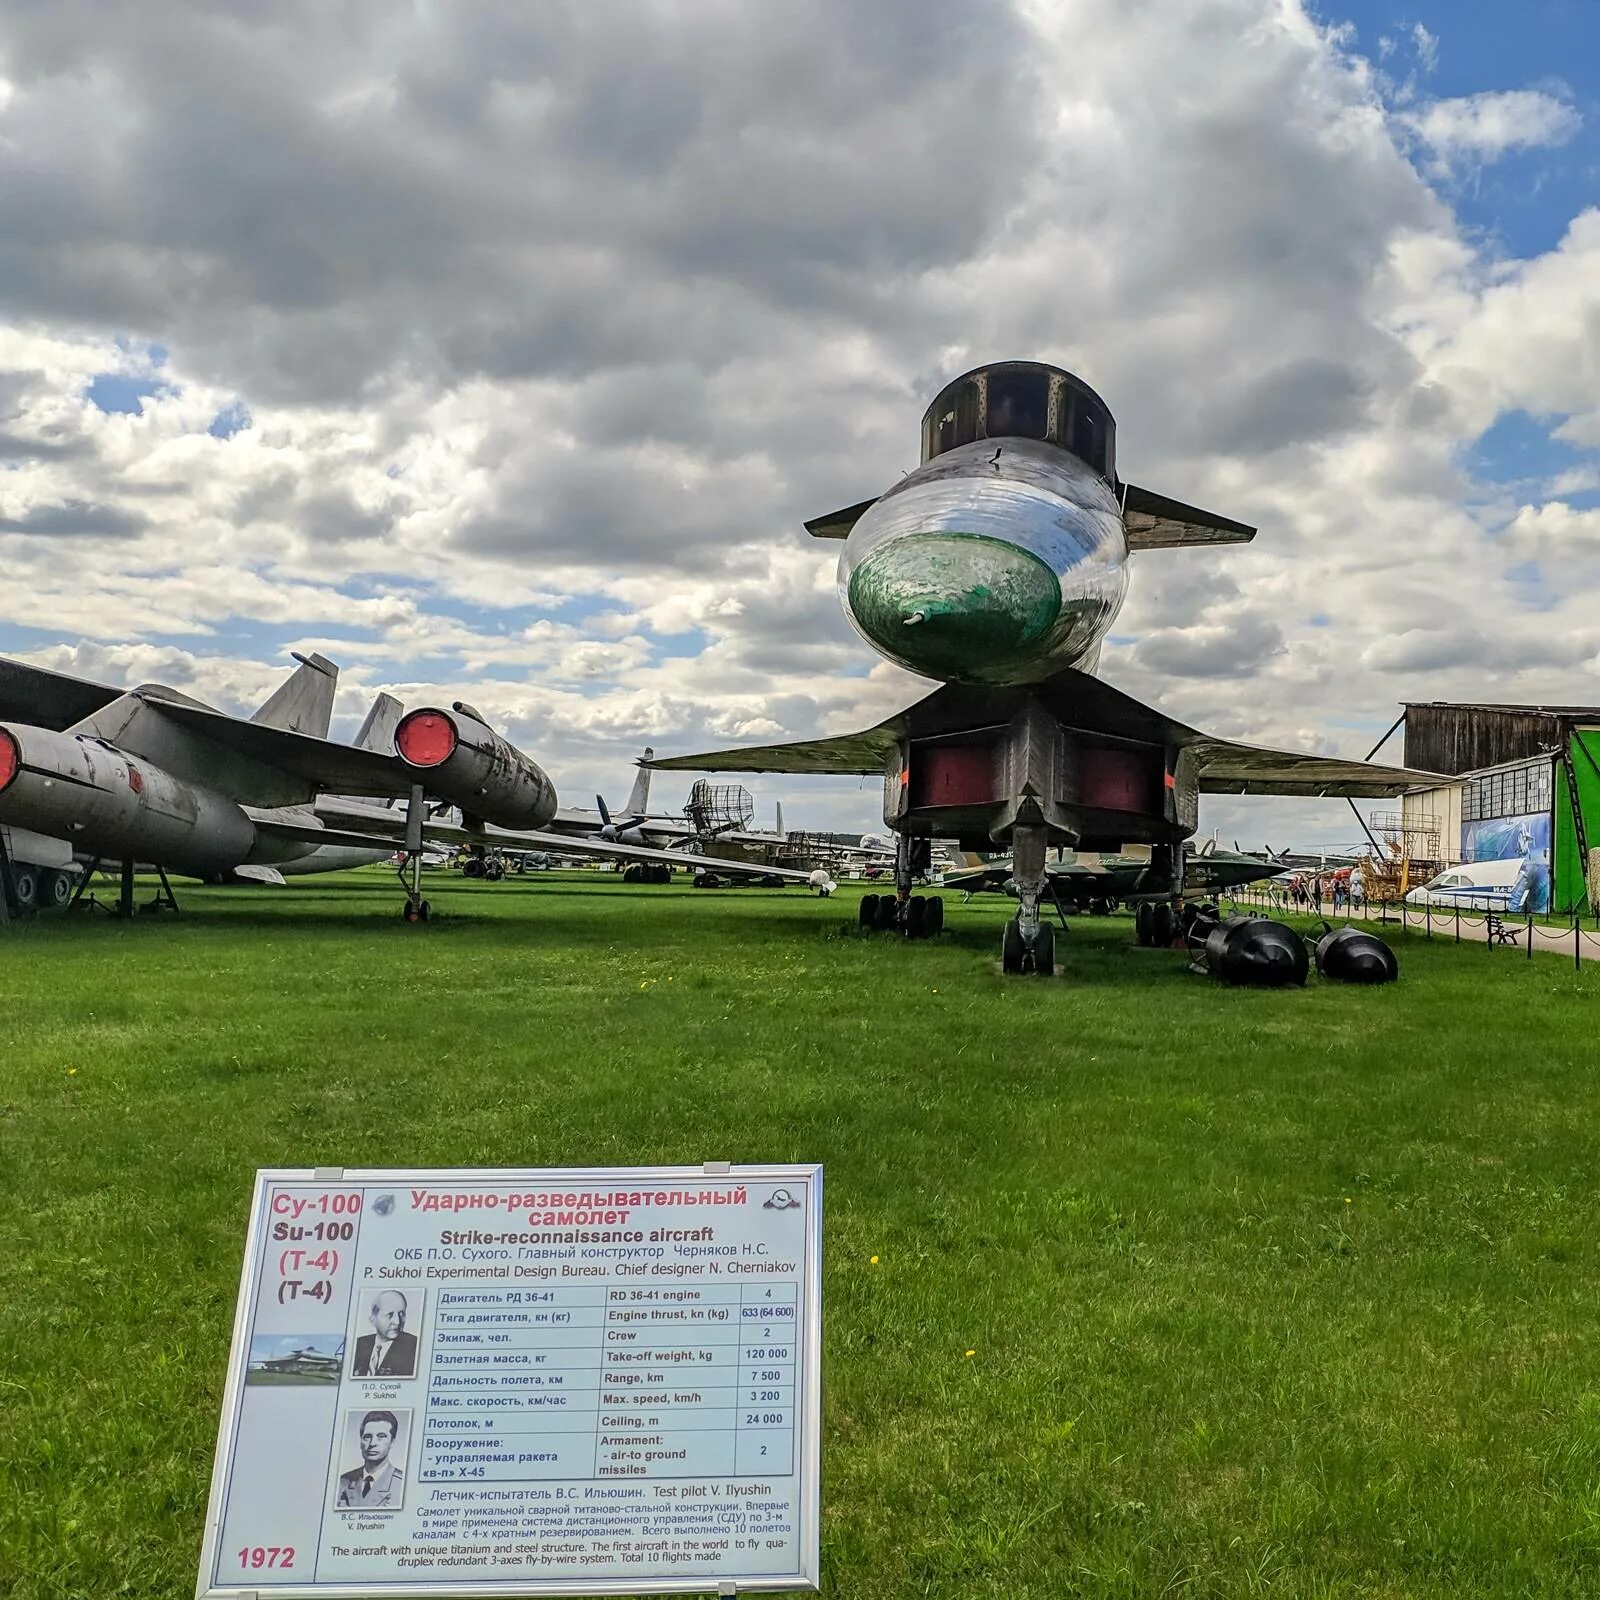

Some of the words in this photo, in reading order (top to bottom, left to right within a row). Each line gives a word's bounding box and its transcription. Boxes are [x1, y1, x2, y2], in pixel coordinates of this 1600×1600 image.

[411, 1186, 746, 1212] Ударно-разведывательный
[272, 1193, 361, 1219] Су-100
[528, 1210, 630, 1226] самолет
[272, 1221, 353, 1241] Su-100
[440, 1228, 643, 1245] Strike-reconnaissance
[649, 1226, 714, 1242] aircraft
[393, 1247, 422, 1260] ОКБ
[427, 1247, 456, 1260] П.О.
[461, 1247, 512, 1262] Сухого.
[517, 1245, 576, 1259] Главный
[580, 1247, 664, 1260] конструктор
[673, 1244, 737, 1259] Черняков
[742, 1242, 768, 1255] Н.С.
[363, 1266, 373, 1278] P.
[378, 1266, 422, 1278] Sukhoi
[426, 1265, 509, 1280] Experimental
[513, 1265, 557, 1279] Design
[561, 1264, 609, 1276] Bureau.
[614, 1262, 648, 1275] Chief
[651, 1262, 705, 1277] designer
[709, 1261, 722, 1274] N.
[727, 1260, 796, 1273] Cherniakov
[440, 1293, 502, 1304] Двигатель
[506, 1292, 521, 1303] РД
[524, 1292, 554, 1302] 36-41
[609, 1291, 626, 1300] RD
[630, 1290, 658, 1300] 36-41
[662, 1289, 700, 1301] engine
[765, 1288, 771, 1298] 4
[439, 1313, 464, 1322] Тяга
[466, 1314, 531, 1323] двигателя,
[551, 1311, 570, 1323] (кг)
[608, 1310, 647, 1322] Engine
[651, 1309, 687, 1320] thrust,
[690, 1309, 704, 1318] kn
[707, 1308, 729, 1320] (kg)
[741, 1307, 758, 1317] 633
[759, 1307, 773, 1319] (64
[774, 1307, 794, 1318] 600)
[437, 1333, 484, 1343] Экипаж,
[487, 1334, 511, 1342] чел.
[607, 1330, 636, 1340] Crew
[763, 1327, 770, 1337] 2
[434, 1354, 489, 1364] Взлетная
[493, 1355, 531, 1364] масса,
[535, 1355, 546, 1363] кг
[606, 1351, 652, 1361] Take-off
[654, 1350, 695, 1362] weight,
[699, 1350, 712, 1361] kg
[745, 1349, 765, 1358] 120
[768, 1348, 787, 1358] 000
[432, 1375, 497, 1387] Дальность
[500, 1376, 544, 1385] полета,
[548, 1376, 563, 1384] км
[604, 1373, 643, 1384] Range,
[647, 1372, 663, 1382] km
[751, 1371, 758, 1380] 7
[761, 1370, 780, 1380] 500
[430, 1396, 462, 1406] Макс.
[466, 1398, 524, 1408] скорость,
[527, 1395, 566, 1405] км/час
[602, 1394, 629, 1404] Max.
[632, 1393, 670, 1405] speed,
[674, 1392, 701, 1402] km/h
[750, 1391, 757, 1401] 3
[760, 1390, 779, 1400] 200
[428, 1418, 480, 1429] Потолок,
[601, 1416, 644, 1428] Ceiling,
[648, 1417, 658, 1425] m
[746, 1414, 759, 1424] 24
[762, 1413, 782, 1423] 000
[425, 1438, 503, 1450] Вооружение:
[600, 1435, 663, 1445] Armament:
[644, 1448, 686, 1461] ground
[760, 1445, 767, 1455] 2
[435, 1454, 515, 1465] управляемая
[518, 1453, 557, 1464] ракета
[598, 1464, 646, 1475] missiles
[429, 1489, 551, 1501] Летчик-испытатель
[555, 1487, 579, 1499] В.С.
[584, 1487, 645, 1498] Ильюшин.
[652, 1486, 677, 1497] Test
[681, 1485, 707, 1499] pilot
[710, 1484, 720, 1495] V.
[725, 1483, 771, 1498] Ilyushin
[416, 1506, 461, 1516] Самолет
[463, 1504, 524, 1518] уникальной
[527, 1503, 570, 1516] сварной
[573, 1502, 671, 1514] титаново-стальной
[674, 1503, 741, 1513] конструкции.
[745, 1500, 789, 1512] Впервые
[422, 1520, 428, 1528] в
[431, 1519, 458, 1529] мире
[461, 1518, 518, 1529] применена
[521, 1518, 563, 1526] система
[565, 1516, 650, 1526] дистанционного
[653, 1515, 713, 1525] управления
[716, 1512, 746, 1525] (СДУ)
[765, 1511, 782, 1521] 3-м
[412, 1531, 456, 1539] каналам
[462, 1530, 468, 1539] с
[471, 1528, 488, 1538] 4-х
[491, 1529, 536, 1539] кратным
[539, 1527, 634, 1539] резервированием.
[642, 1525, 670, 1535] Всего
[674, 1525, 730, 1534] выполнено
[734, 1523, 746, 1533] 10
[749, 1524, 791, 1533] полетов
[330, 1546, 349, 1556] The
[351, 1544, 388, 1556] aircraft
[390, 1545, 411, 1555] with
[414, 1545, 448, 1556] unique
[450, 1544, 490, 1554] titanium
[493, 1543, 512, 1553] and
[514, 1542, 538, 1553] steel
[540, 1543, 587, 1553] structure.
[591, 1541, 610, 1551] The
[612, 1541, 632, 1551] first
[634, 1540, 668, 1551] aircraft
[671, 1540, 680, 1549] in
[683, 1539, 699, 1549] the
[702, 1539, 728, 1549] world
[735, 1539, 745, 1549] to
[747, 1538, 760, 1550] fly
[765, 1539, 787, 1550] qua-
[238, 1547, 295, 1568] 1972
[397, 1556, 434, 1568] druplex
[437, 1555, 488, 1566] redundant
[490, 1555, 522, 1565] 3-axes
[525, 1554, 577, 1566] fly-by-wire
[579, 1553, 616, 1565] system.
[620, 1552, 643, 1562] Total
[647, 1552, 659, 1562] 10
[662, 1551, 691, 1563] flights
[694, 1550, 721, 1561] made
